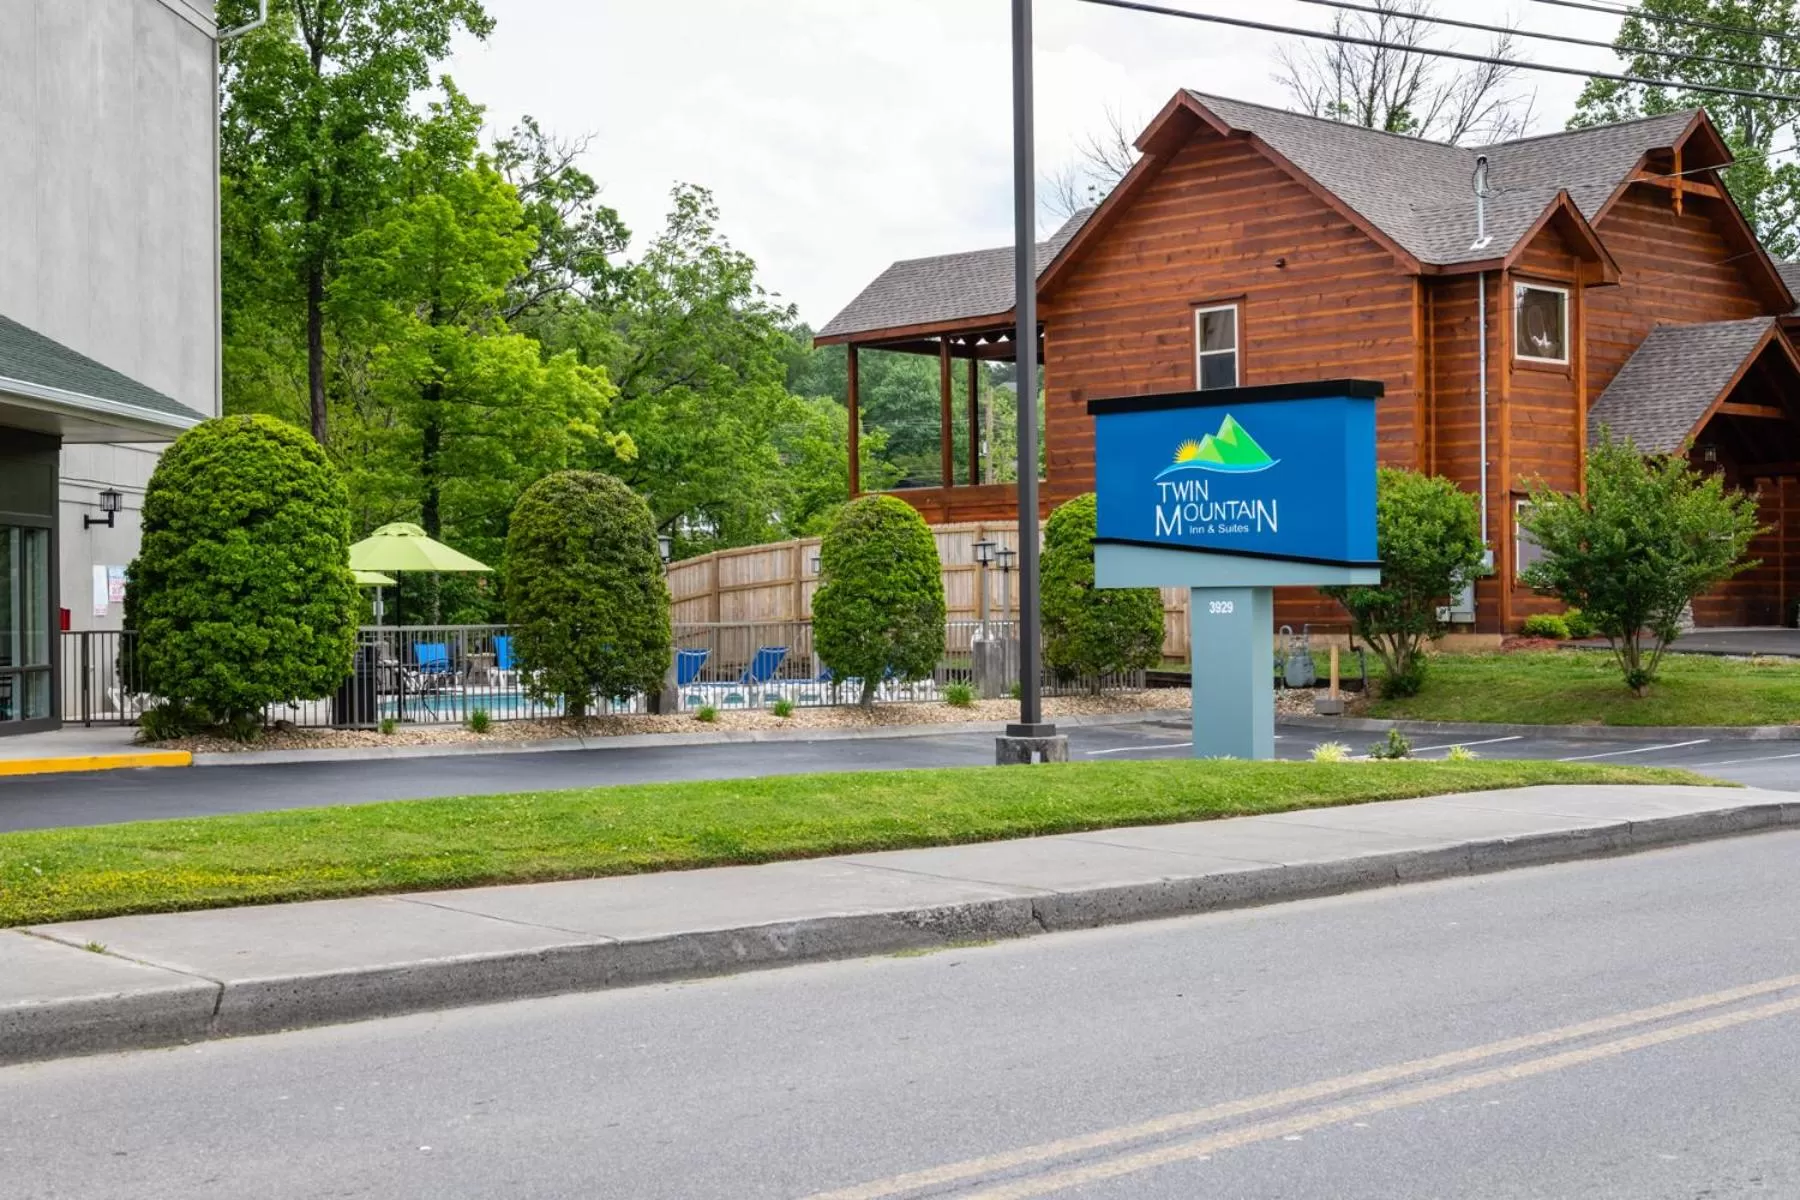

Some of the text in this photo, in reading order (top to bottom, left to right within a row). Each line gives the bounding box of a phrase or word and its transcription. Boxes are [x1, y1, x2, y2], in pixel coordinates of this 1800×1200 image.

[1156, 480, 1208, 503] TWIN
[1155, 499, 1278, 536] MOUNTAIN
[1189, 523, 1249, 534] Inn & Suites
[1209, 600, 1233, 614] 3929
